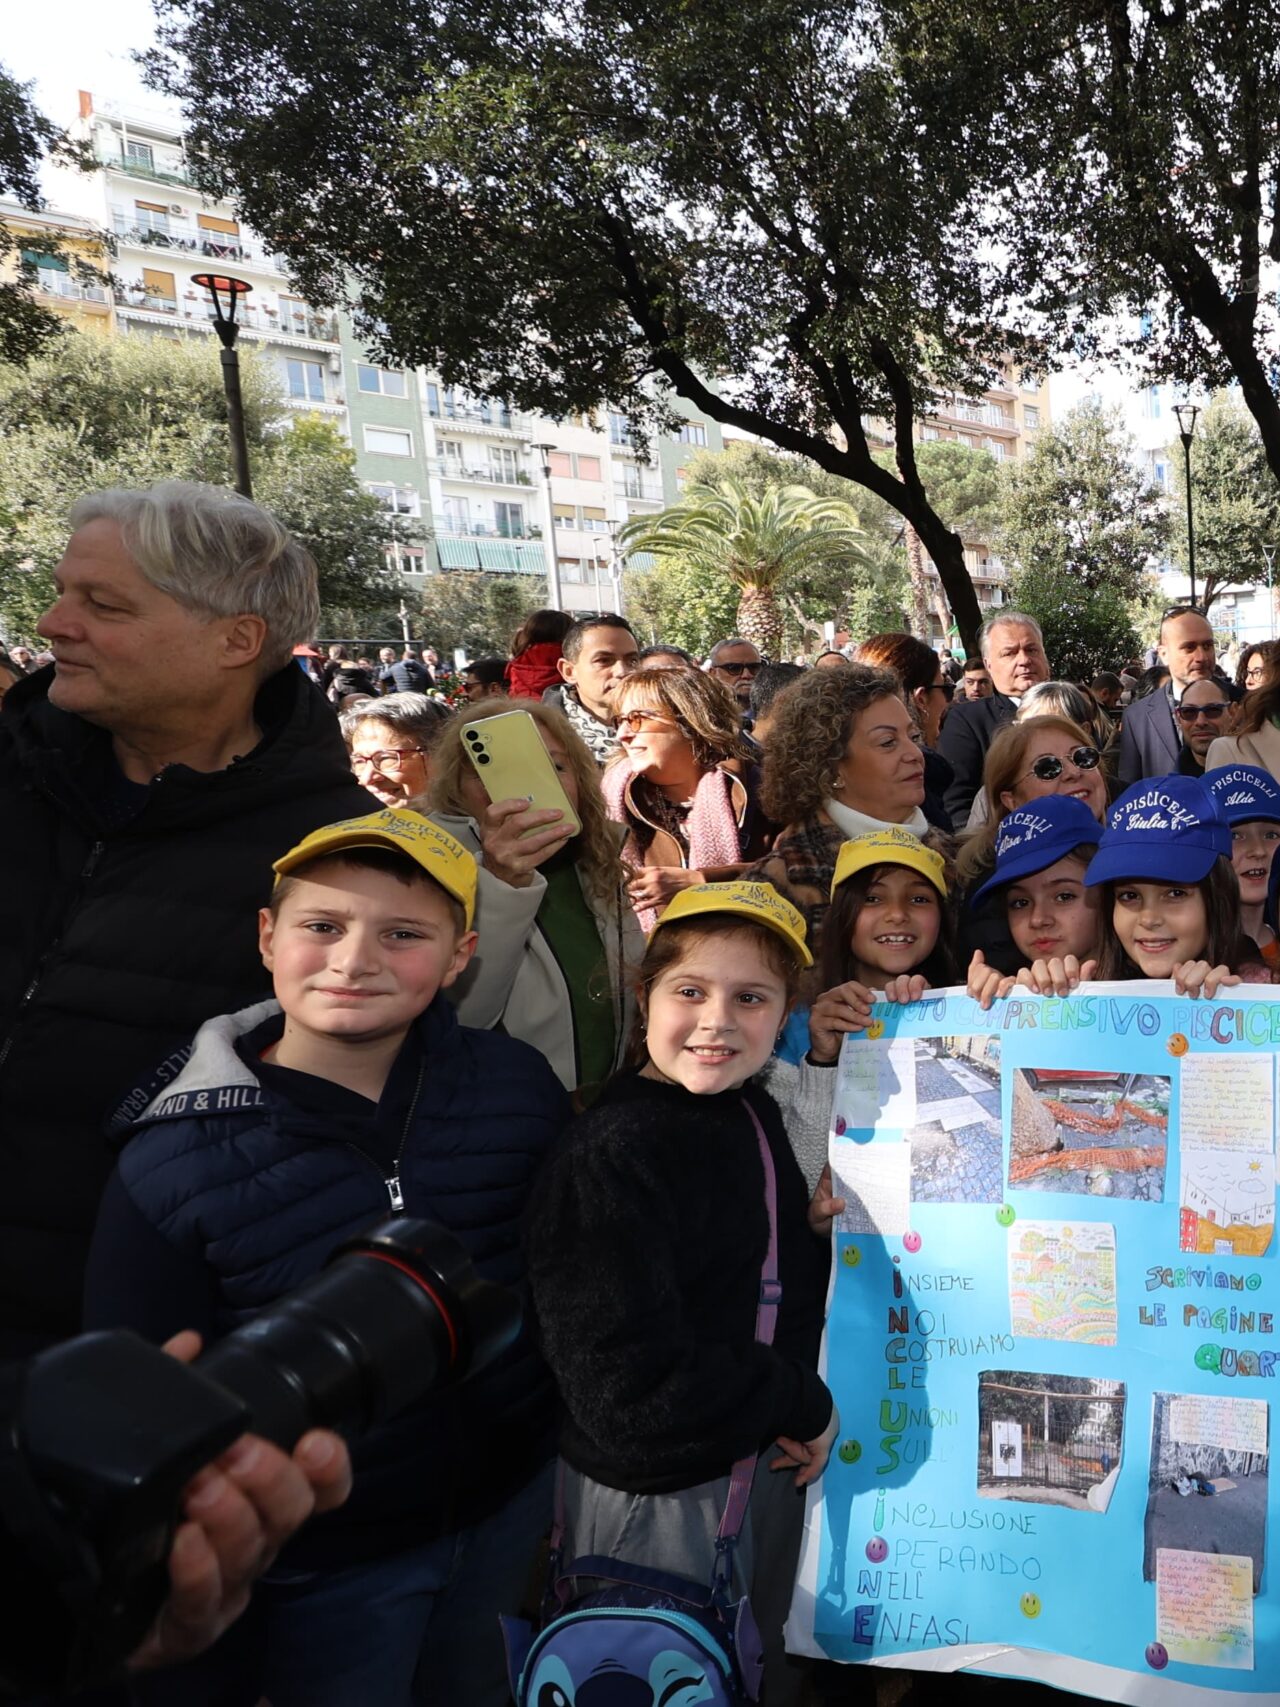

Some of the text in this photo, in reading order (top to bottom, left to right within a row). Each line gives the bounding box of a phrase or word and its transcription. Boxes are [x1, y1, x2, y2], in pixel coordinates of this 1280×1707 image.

[1225, 791, 1256, 806] Aldo
[1126, 812, 1169, 831] Giulia
[954, 995, 1161, 1037] COMPRENSIVO
[193, 1091, 209, 1111] &
[888, 1306, 947, 1336] NOI
[1139, 1303, 1168, 1328] LE
[885, 1333, 1016, 1364] COSTRUIAMO
[888, 1366, 926, 1390] LE
[853, 1604, 970, 1646] ENFASI
